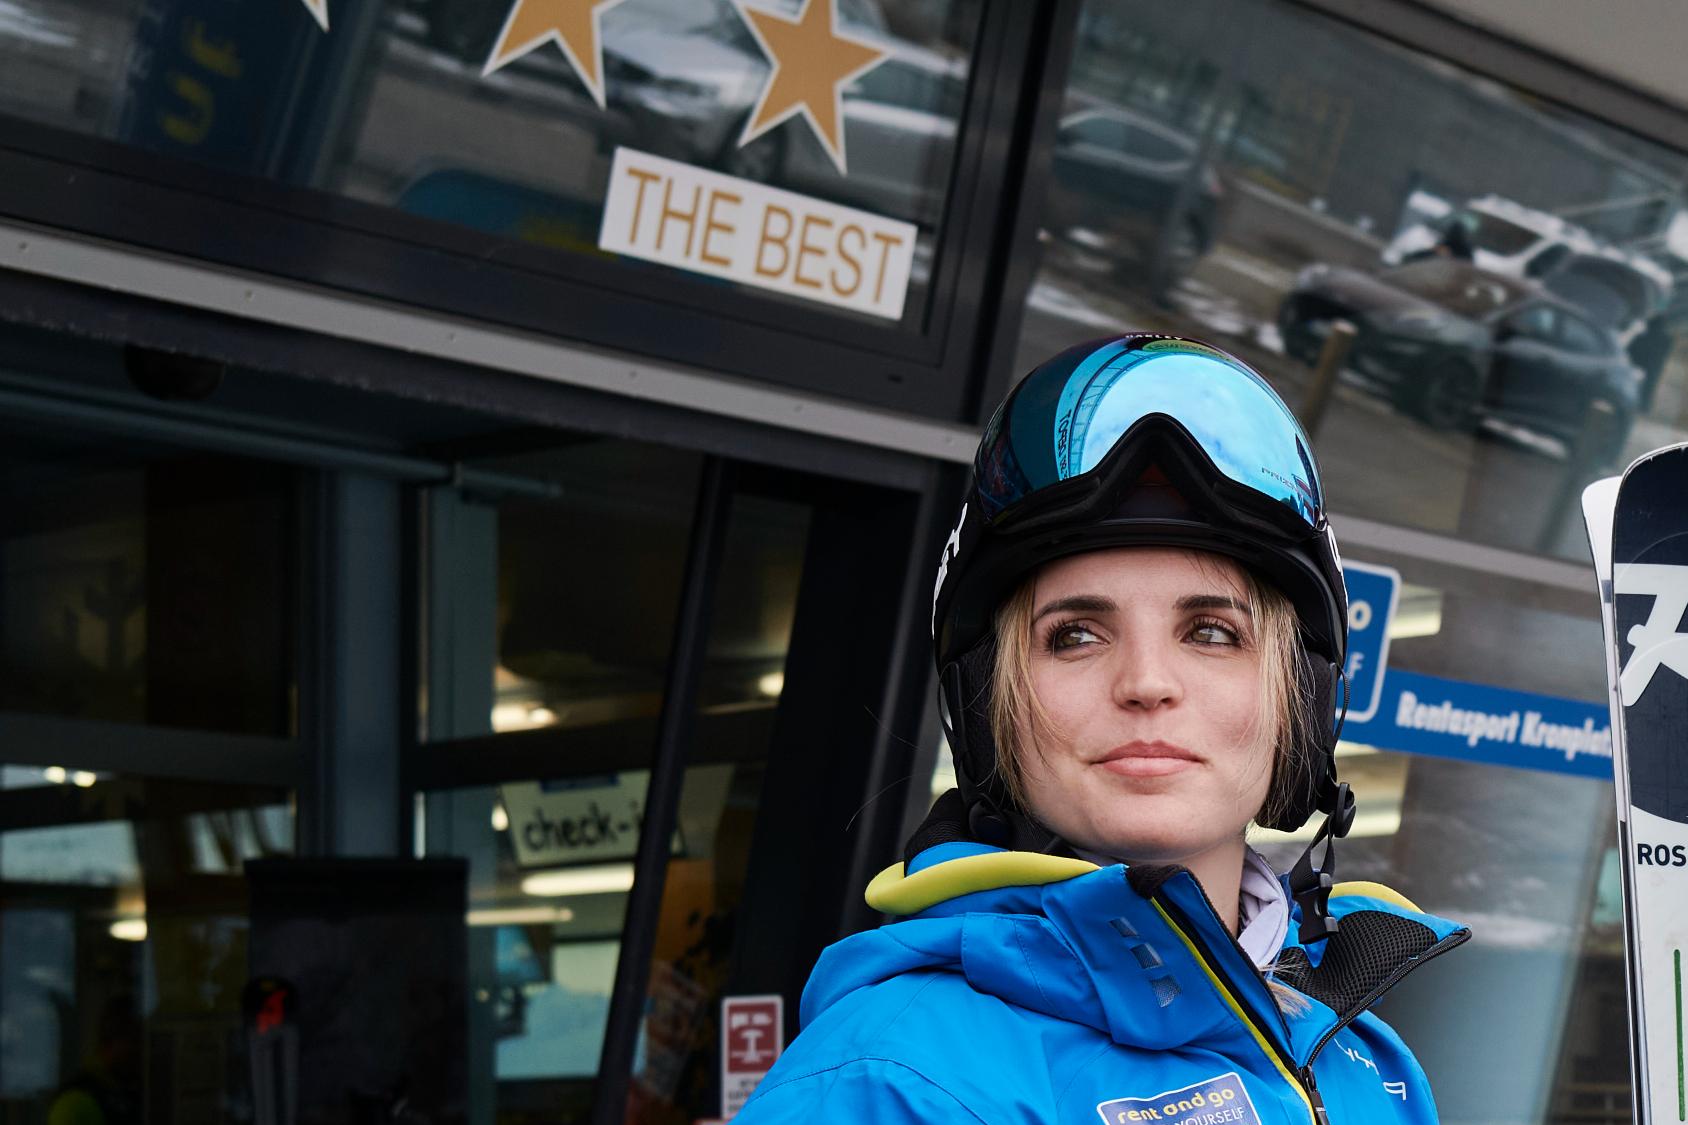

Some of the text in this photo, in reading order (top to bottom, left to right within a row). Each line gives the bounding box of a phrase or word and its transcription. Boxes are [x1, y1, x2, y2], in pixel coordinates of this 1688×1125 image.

[626, 166, 903, 304] THE BEST
[1520, 711, 1614, 762] Kronplat
[1117, 1087, 1235, 1124] rent and go
